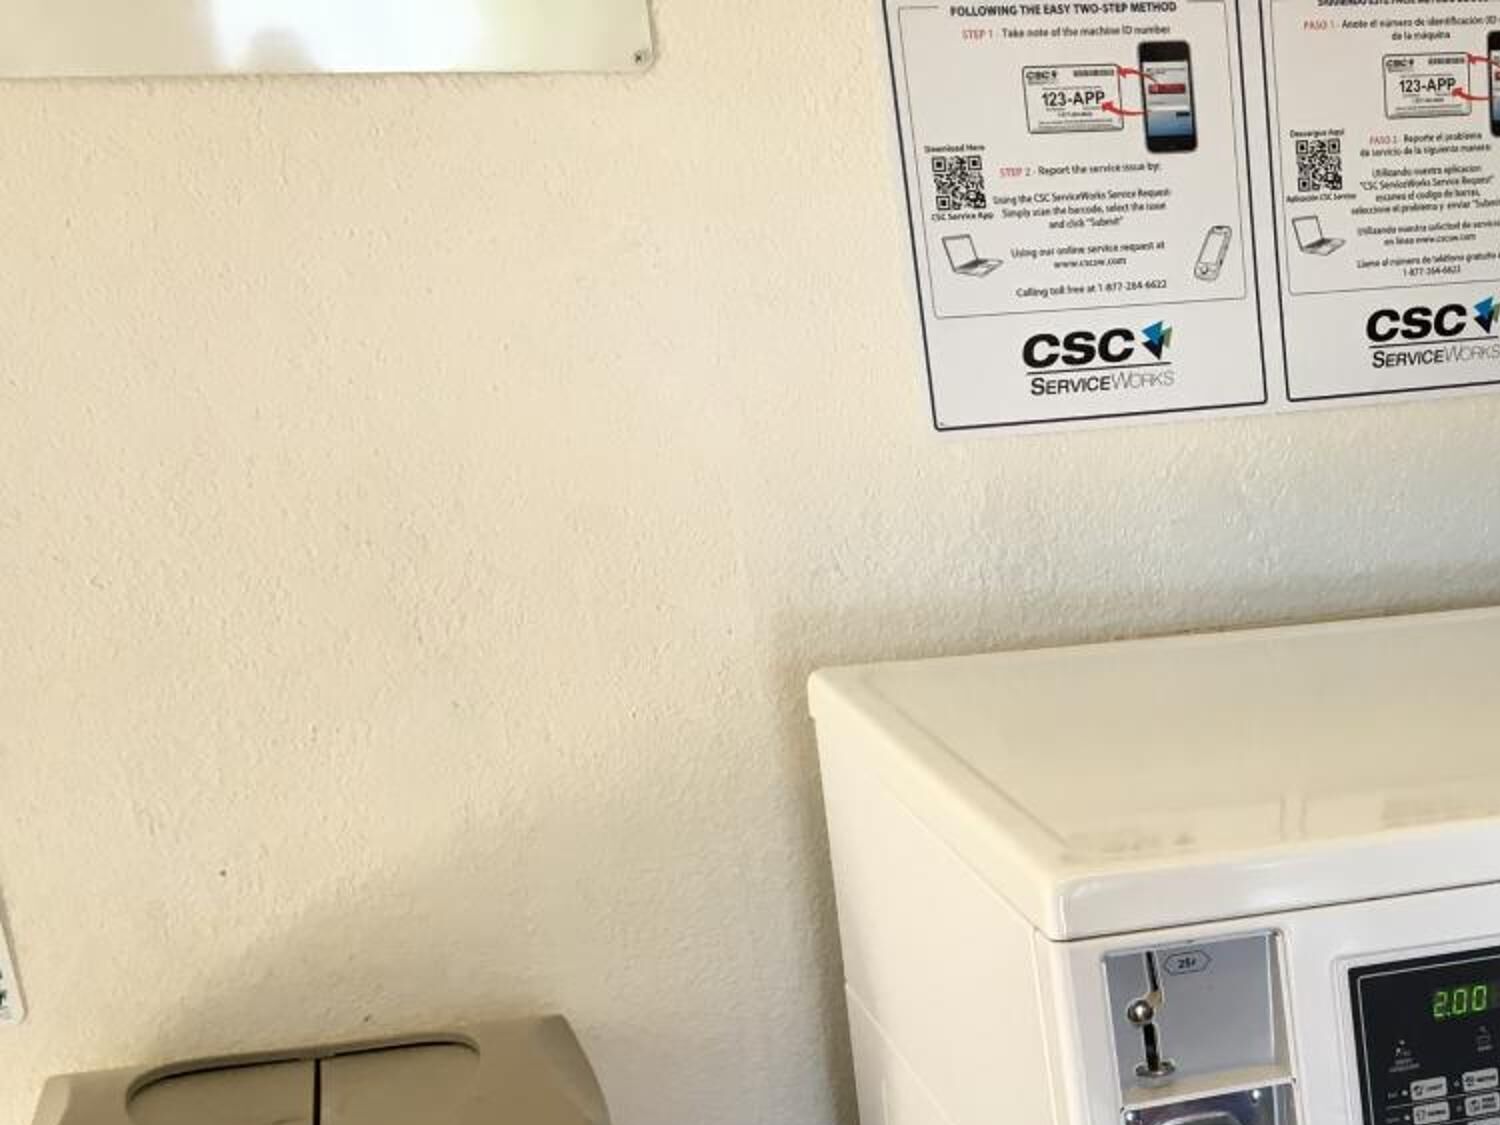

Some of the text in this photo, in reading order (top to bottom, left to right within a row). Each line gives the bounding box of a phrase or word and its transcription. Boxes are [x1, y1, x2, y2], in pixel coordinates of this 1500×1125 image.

[950, 2, 1177, 16] FOLLOWING THE EASY TWO-STEP METHOD
[1303, 21, 1327, 30] PASO
[1342, 20, 1368, 28] Anote
[1370, 20, 1377, 28] el
[1380, 19, 1412, 27] número
[1414, 18, 1425, 26] de
[1427, 17, 1483, 26] identificación
[962, 30, 988, 39] STEP
[1002, 28, 1024, 37] Take
[1027, 29, 1047, 37] note
[1050, 27, 1061, 37] of
[1063, 27, 1079, 36] the
[1080, 27, 1120, 35] machine
[1122, 25, 1132, 35] ID
[1134, 26, 1170, 34] number
[1392, 32, 1450, 40] de la máquina
[1399, 77, 1456, 92] 123-APP
[1042, 90, 1105, 106] 123-APP
[1404, 134, 1433, 143] Reporte
[1403, 146, 1412, 154] de
[1423, 146, 1458, 155] siguiente
[1038, 166, 1070, 176] Report
[1072, 165, 1086, 173] the
[1432, 178, 1459, 186] Service
[993, 196, 1016, 206] Using
[1018, 195, 1031, 203] the
[1034, 193, 1050, 202] CSC
[1052, 192, 1106, 201] ServiceWorks
[1108, 190, 1135, 198] Service
[1002, 209, 1030, 218] Simply
[1033, 208, 1049, 216] scan
[1052, 206, 1066, 215] the
[1106, 203, 1129, 212] select
[1131, 202, 1144, 211] the
[1049, 220, 1064, 228] and
[1066, 219, 1084, 228] click
[1010, 248, 1037, 259] Using
[1039, 248, 1054, 256] our
[1056, 246, 1084, 255] online
[1087, 245, 1118, 253] service
[1120, 242, 1154, 252] request
[1015, 288, 1048, 298] Calling
[1050, 286, 1064, 295] toll
[1366, 304, 1467, 342] CSC
[1022, 328, 1135, 368] CSC
[1433, 985, 1487, 1018] 2.00
